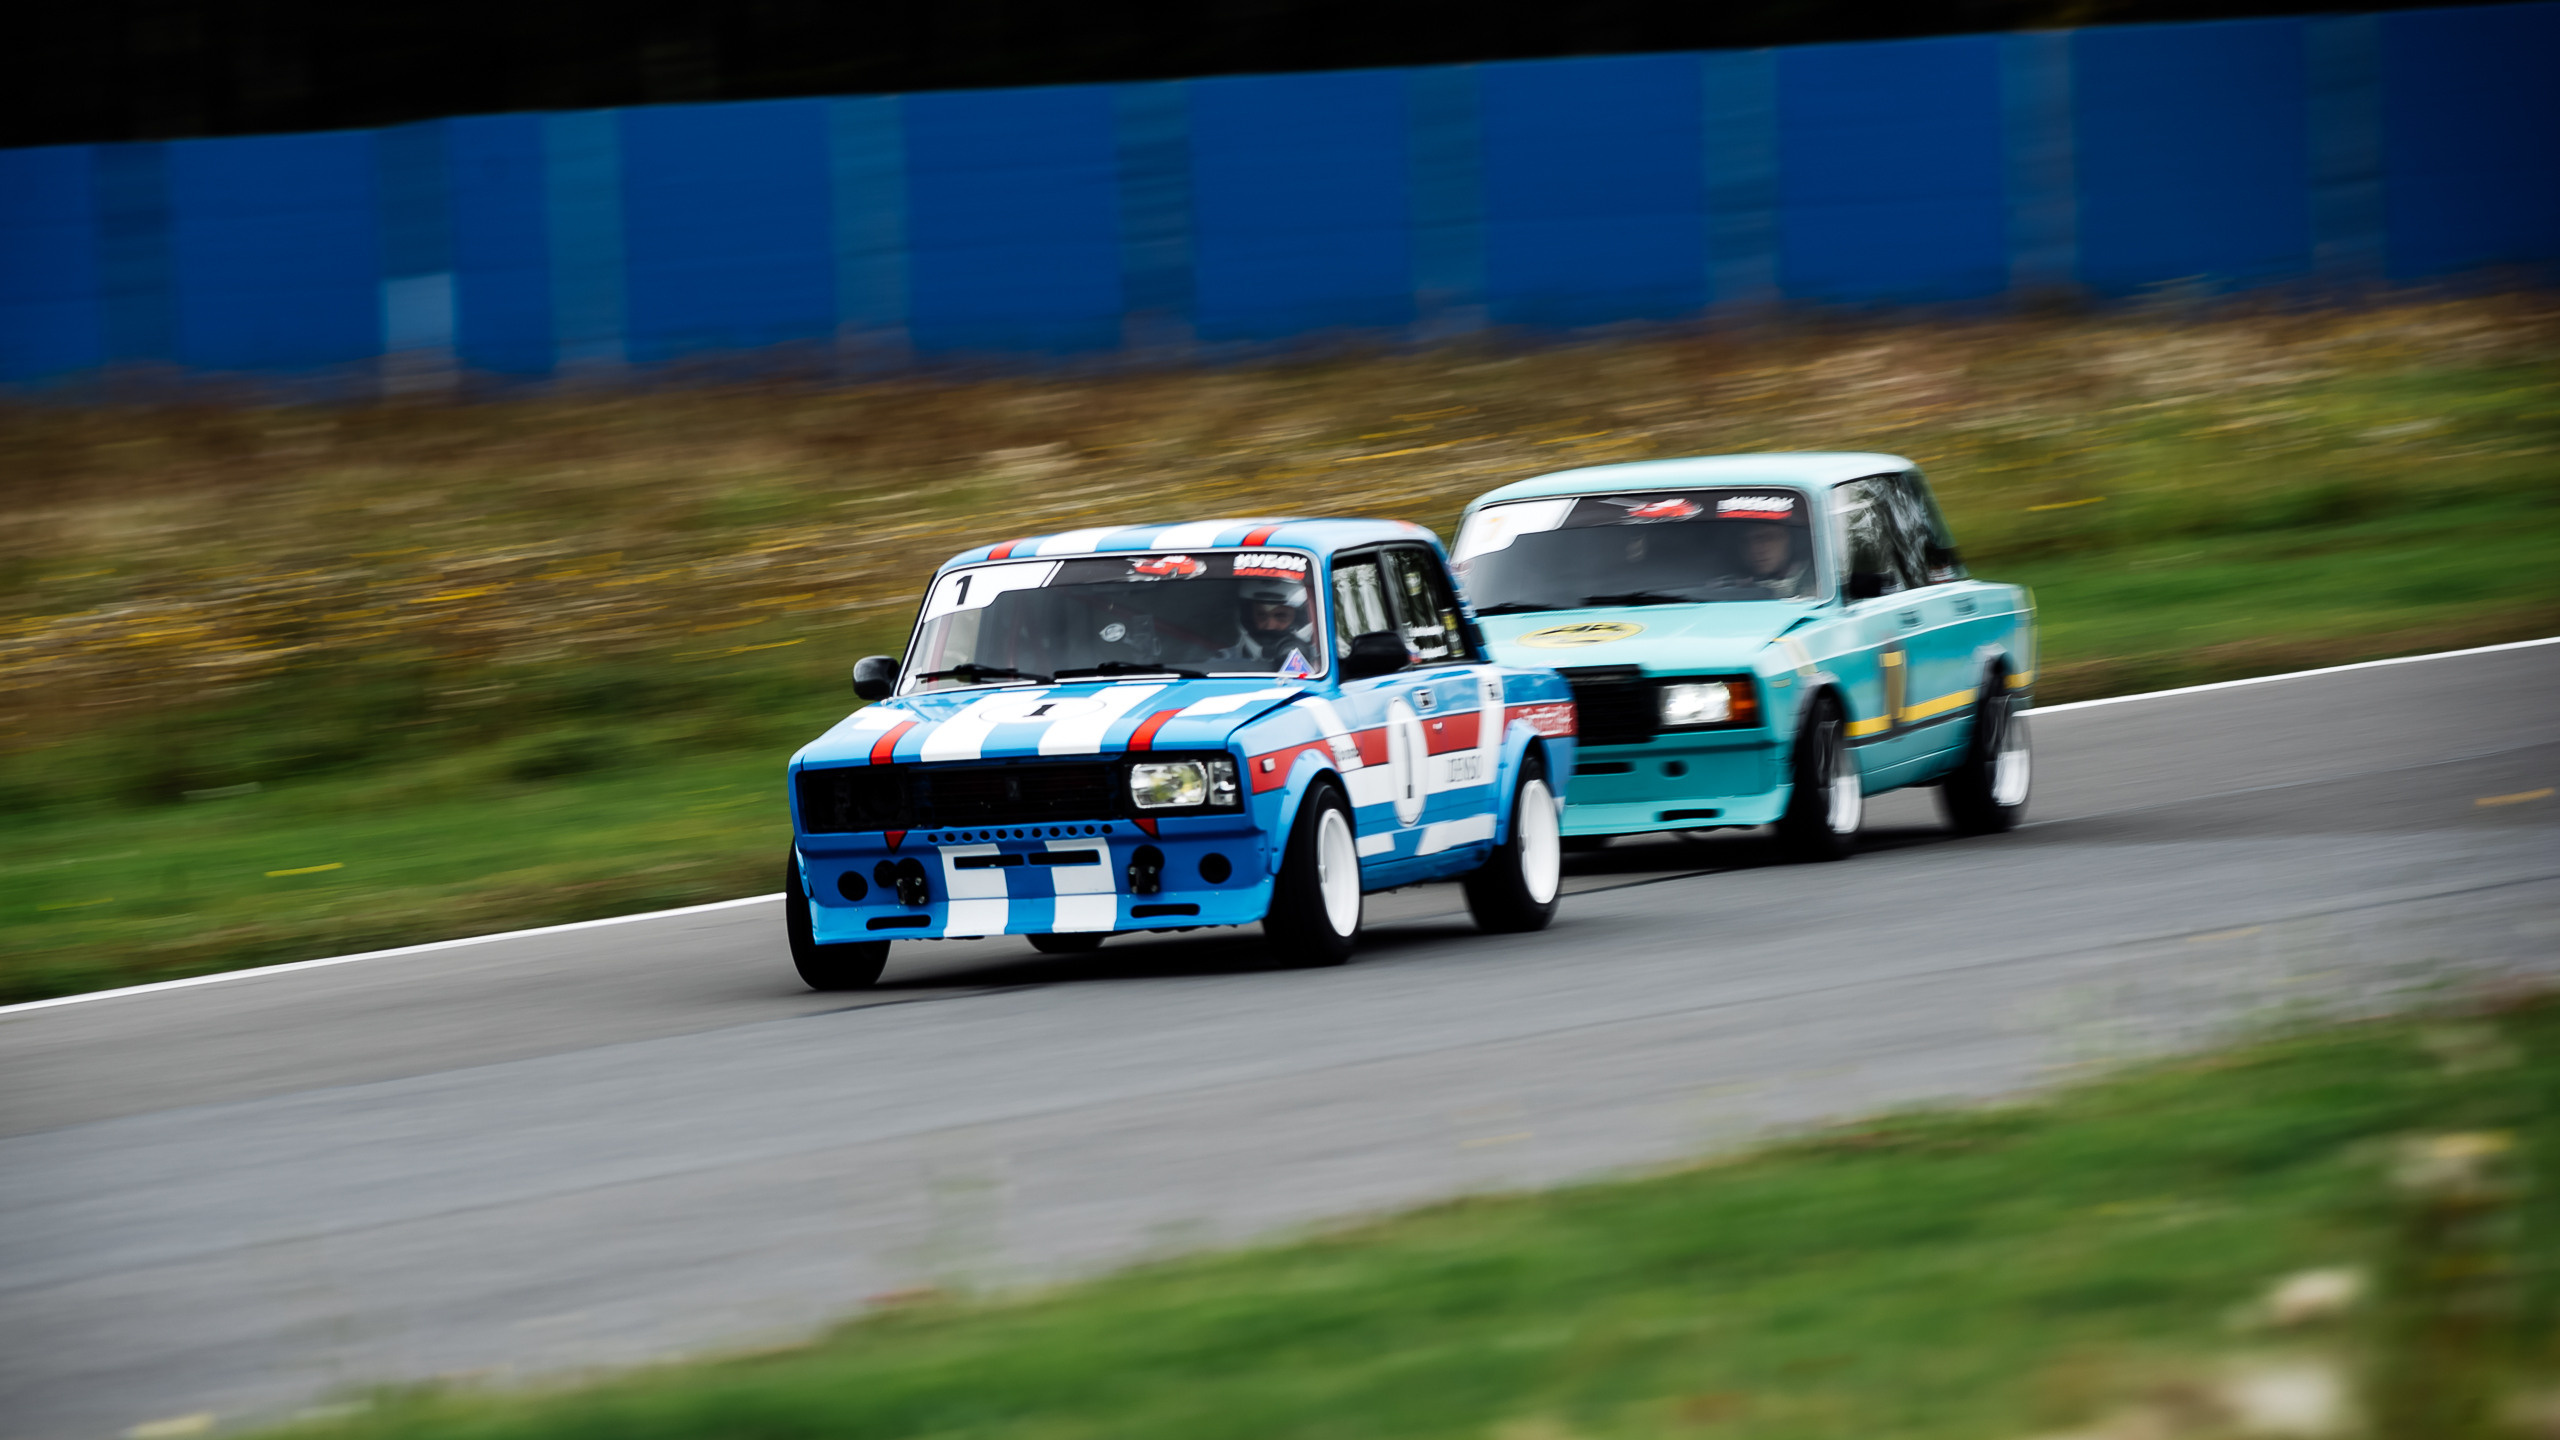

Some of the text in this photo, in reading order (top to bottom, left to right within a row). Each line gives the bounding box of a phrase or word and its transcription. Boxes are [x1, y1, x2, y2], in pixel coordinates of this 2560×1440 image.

[955, 574, 974, 606] 1
[1022, 702, 1059, 718] 1
[1401, 722, 1416, 800] 1
